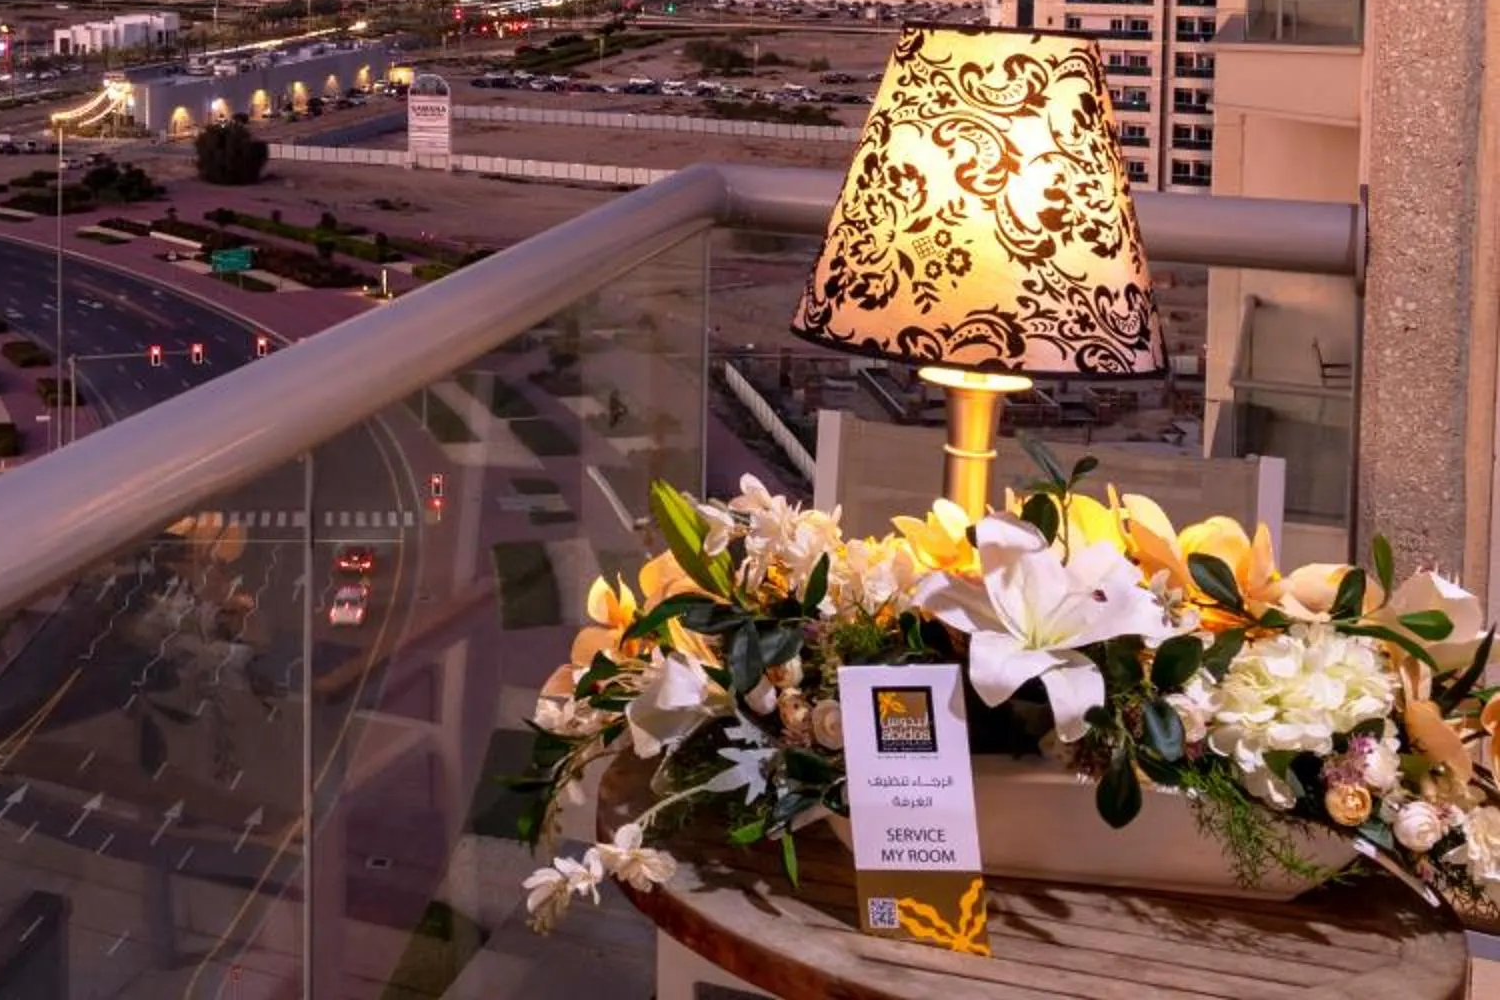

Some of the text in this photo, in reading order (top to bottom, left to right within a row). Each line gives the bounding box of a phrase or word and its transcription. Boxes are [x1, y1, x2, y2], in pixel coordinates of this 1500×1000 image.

[885, 827, 947, 843] SERVICE
[881, 848, 956, 863] MY ROOM
